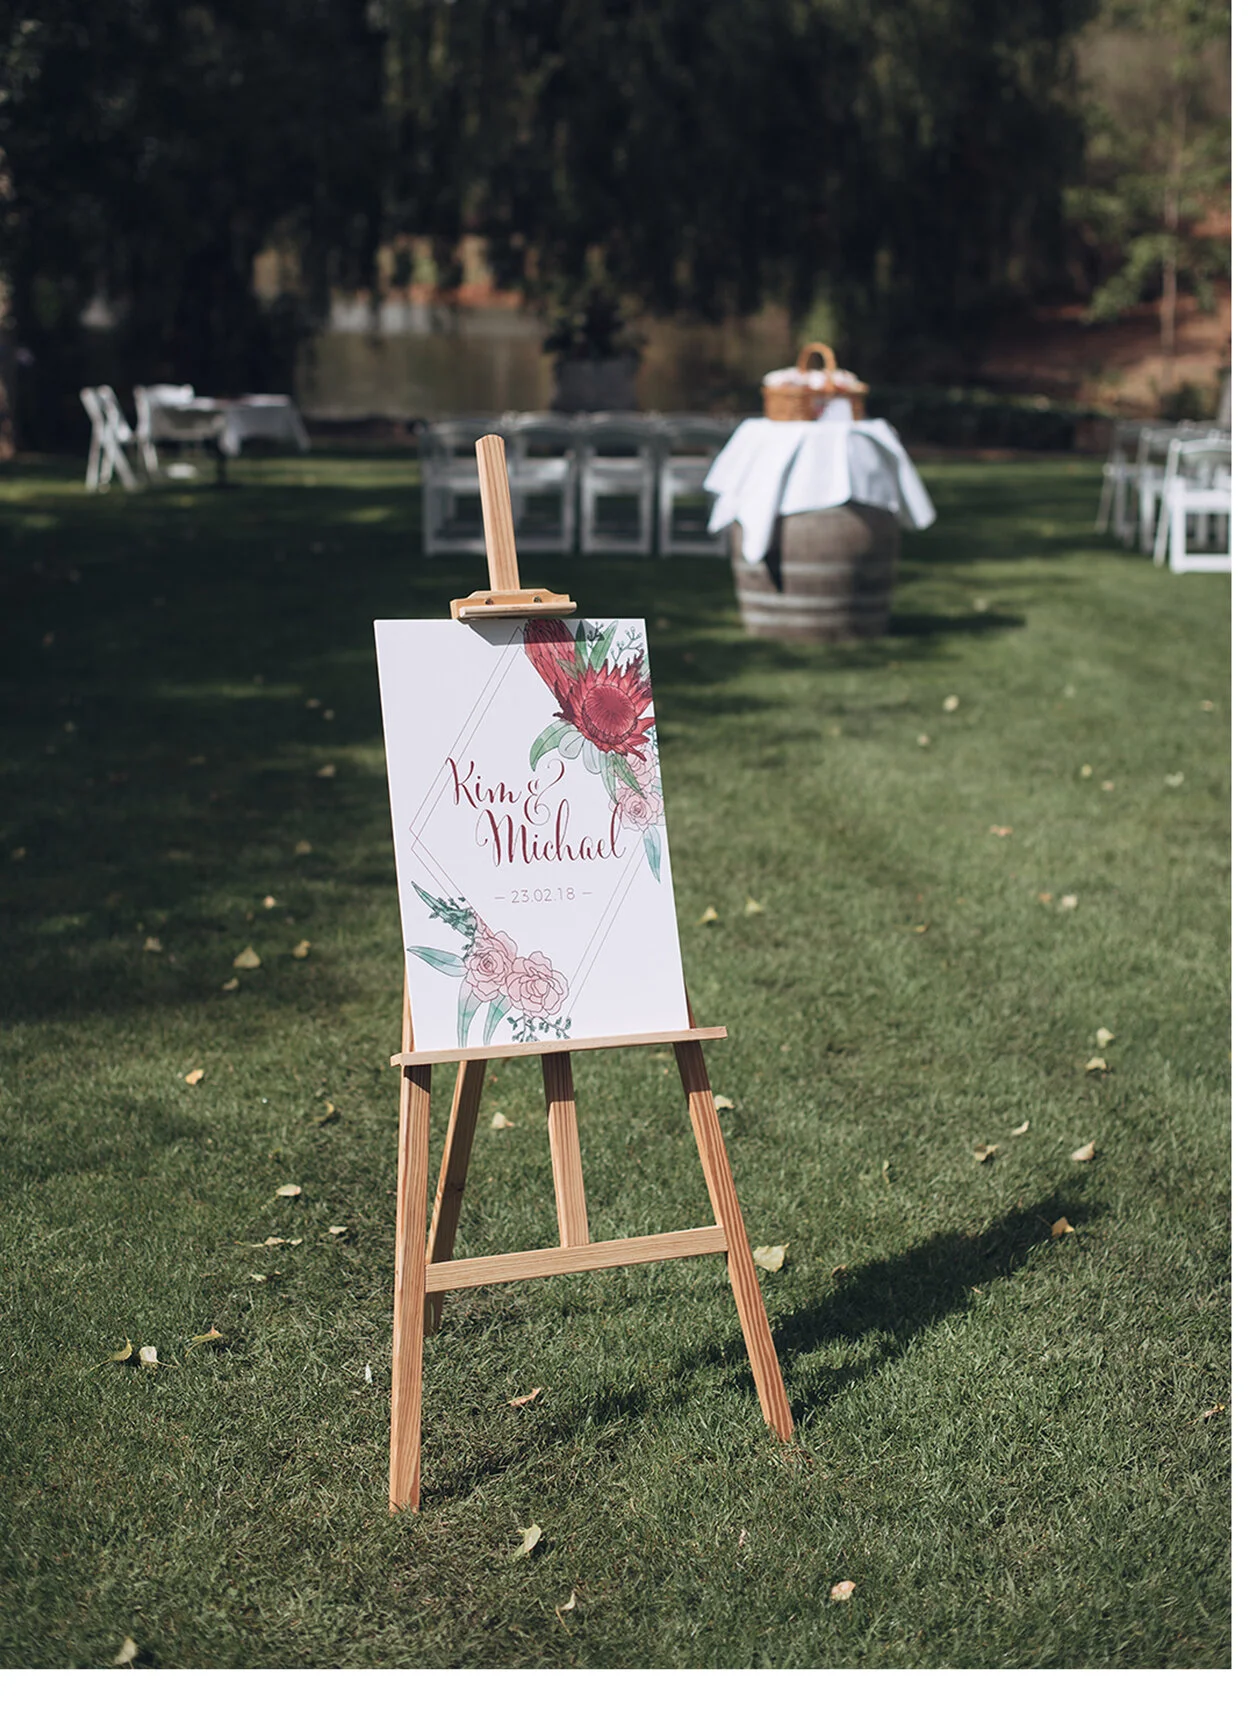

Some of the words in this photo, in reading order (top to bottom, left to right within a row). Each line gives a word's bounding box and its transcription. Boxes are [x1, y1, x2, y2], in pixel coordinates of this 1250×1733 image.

[445, 757, 522, 809] Kim
[524, 759, 565, 826] &
[475, 799, 627, 867] Michael
[511, 887, 576, 904] 23.02.18
